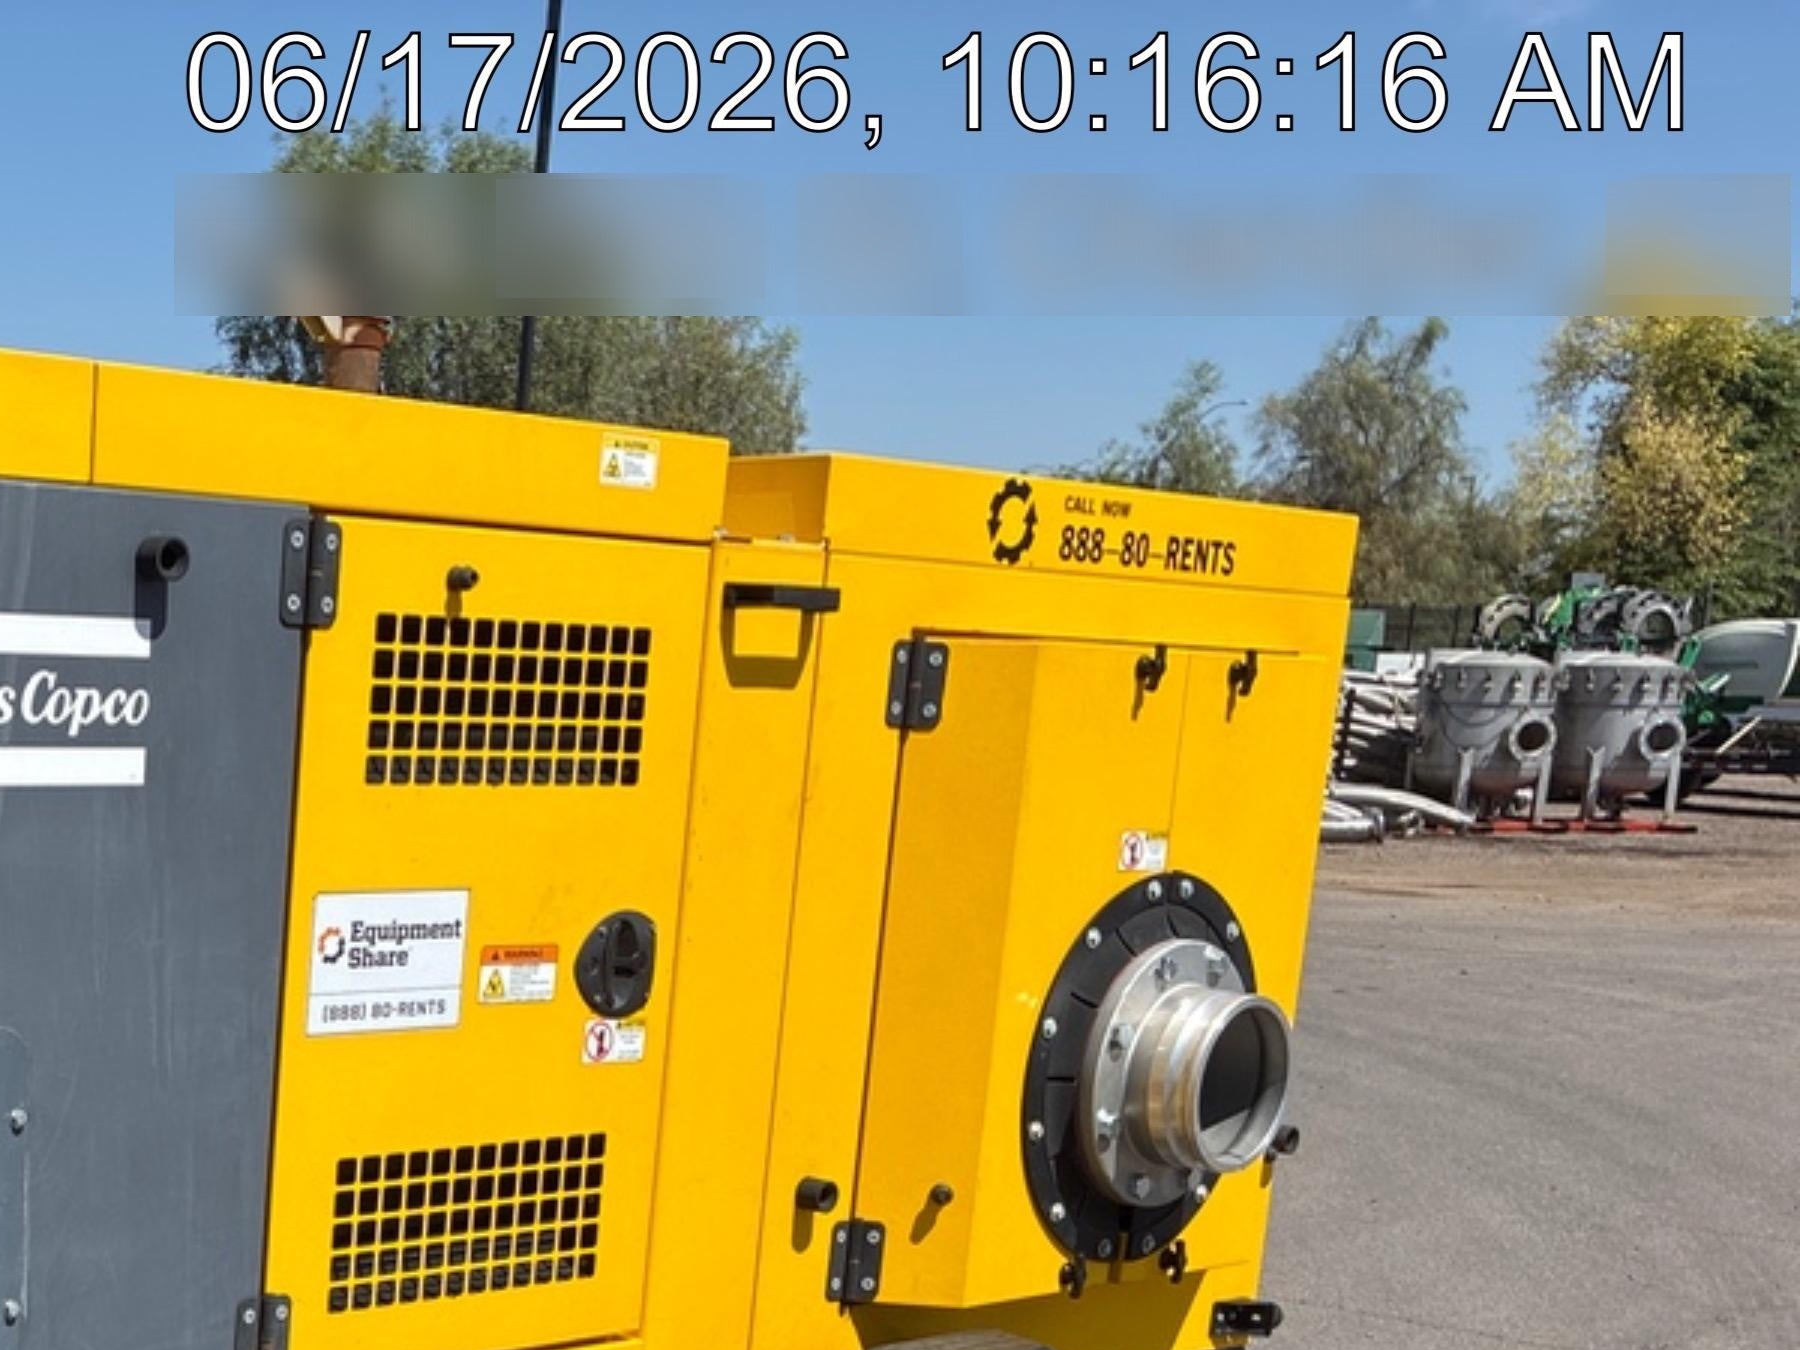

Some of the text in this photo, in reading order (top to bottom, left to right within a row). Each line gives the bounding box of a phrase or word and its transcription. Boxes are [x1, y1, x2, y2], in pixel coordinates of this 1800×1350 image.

[1064, 495, 1132, 519] CALL NOW
[1059, 524, 1237, 577] 888-80-RENTS
[20, 668, 150, 737] Copco
[350, 918, 462, 946] Equipment
[347, 946, 409, 970] Share
[371, 998, 447, 1019] 80-RENTS
